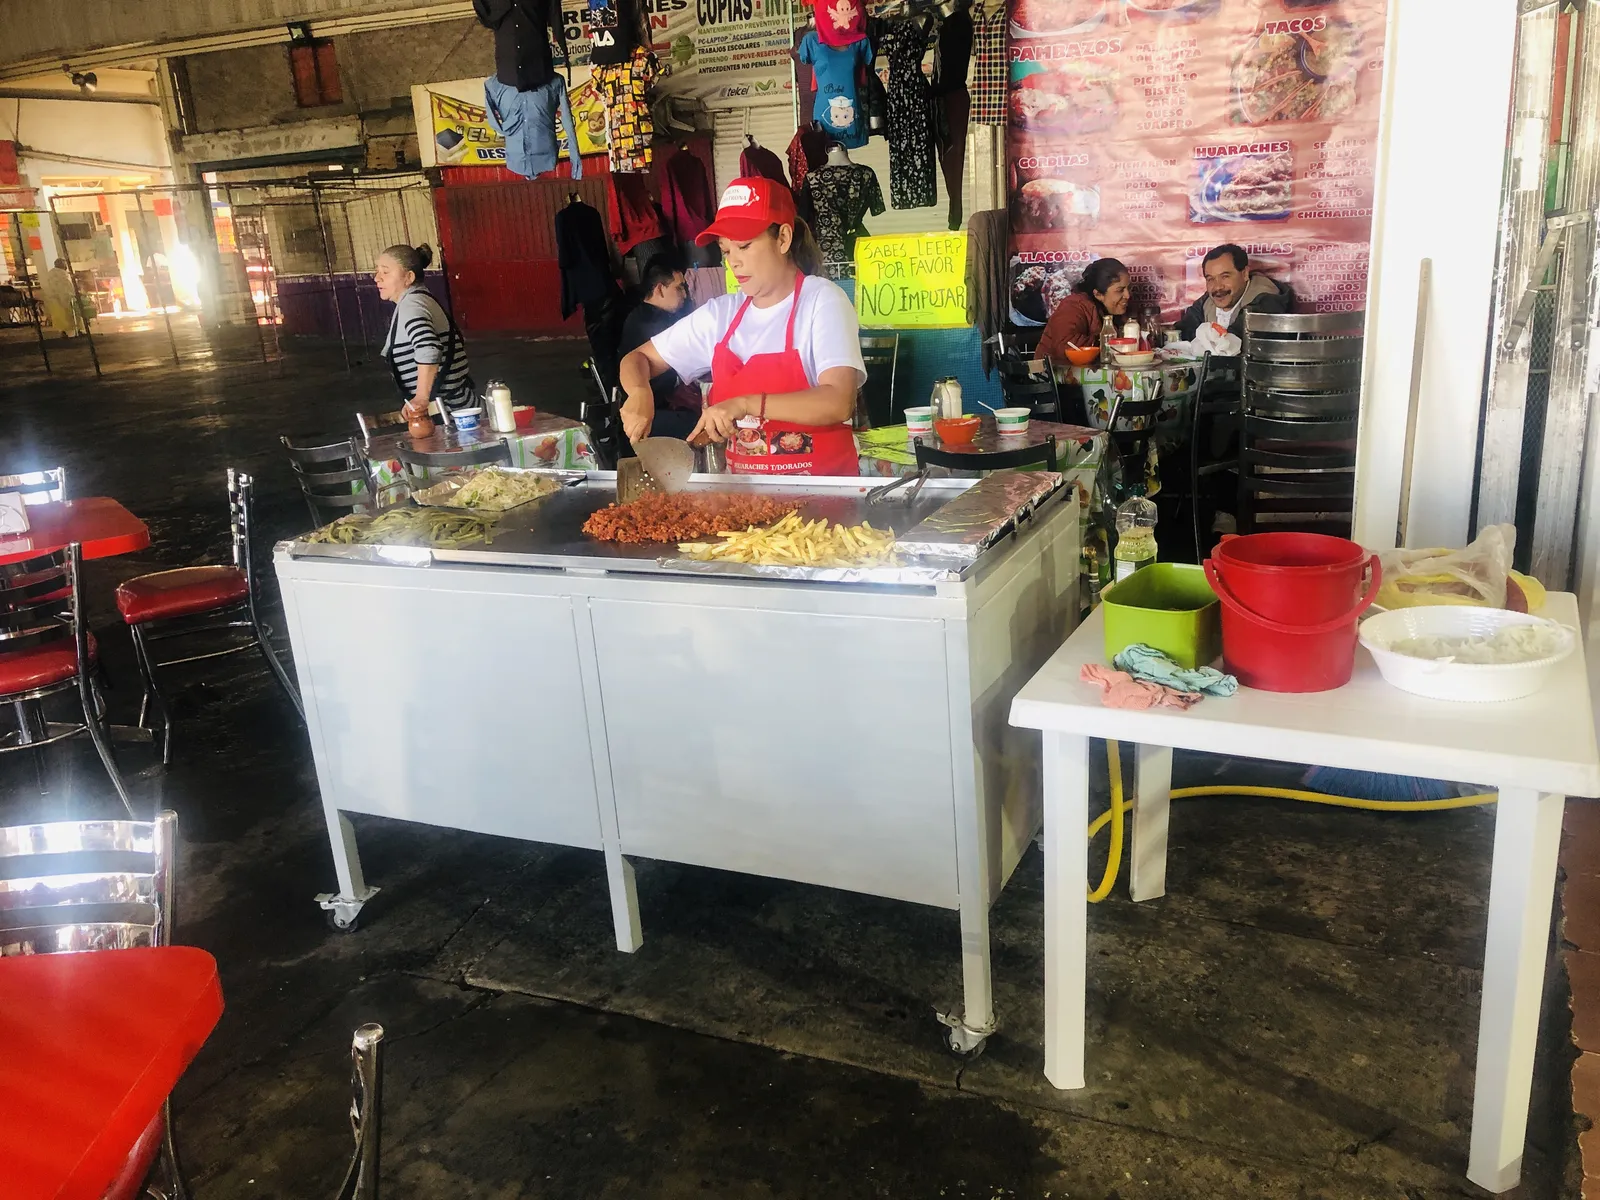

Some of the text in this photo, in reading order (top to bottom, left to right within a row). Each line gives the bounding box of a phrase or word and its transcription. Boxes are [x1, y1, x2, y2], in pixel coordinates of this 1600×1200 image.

[697, 0, 753, 26] COPIAS
[698, 24, 743, 35] MANTENIMIENTO
[744, 19, 780, 29] PREVENTIVO
[1265, 16, 1327, 35] TACOS
[698, 45, 727, 55] TRABAJOS
[727, 42, 761, 52] ESCOLARES
[1010, 39, 1122, 63] PAMBAZOS
[698, 55, 729, 65] REFRENDO
[698, 63, 740, 75] ANTECEDENTES
[751, 59, 777, 68] PENALES
[727, 85, 750, 97] telcel
[1145, 108, 1184, 119] QUESO
[1136, 119, 1194, 131] SUADERO
[1195, 141, 1290, 158] HUARACHES
[1019, 154, 1089, 169] GORDITAS
[863, 237, 963, 260] SABES LEER?
[1186, 242, 1293, 259] QUDILLAS
[1019, 251, 1091, 263] TLACOYOS
[870, 256, 955, 280] POR FAVOR
[1128, 265, 1155, 273] RIJOL
[1305, 273, 1368, 282] PICADILLO
[1312, 283, 1361, 293] HONGOS
[861, 283, 896, 317] NO
[1315, 303, 1354, 313] POLLO
[770, 461, 813, 471] T/DORADOS
